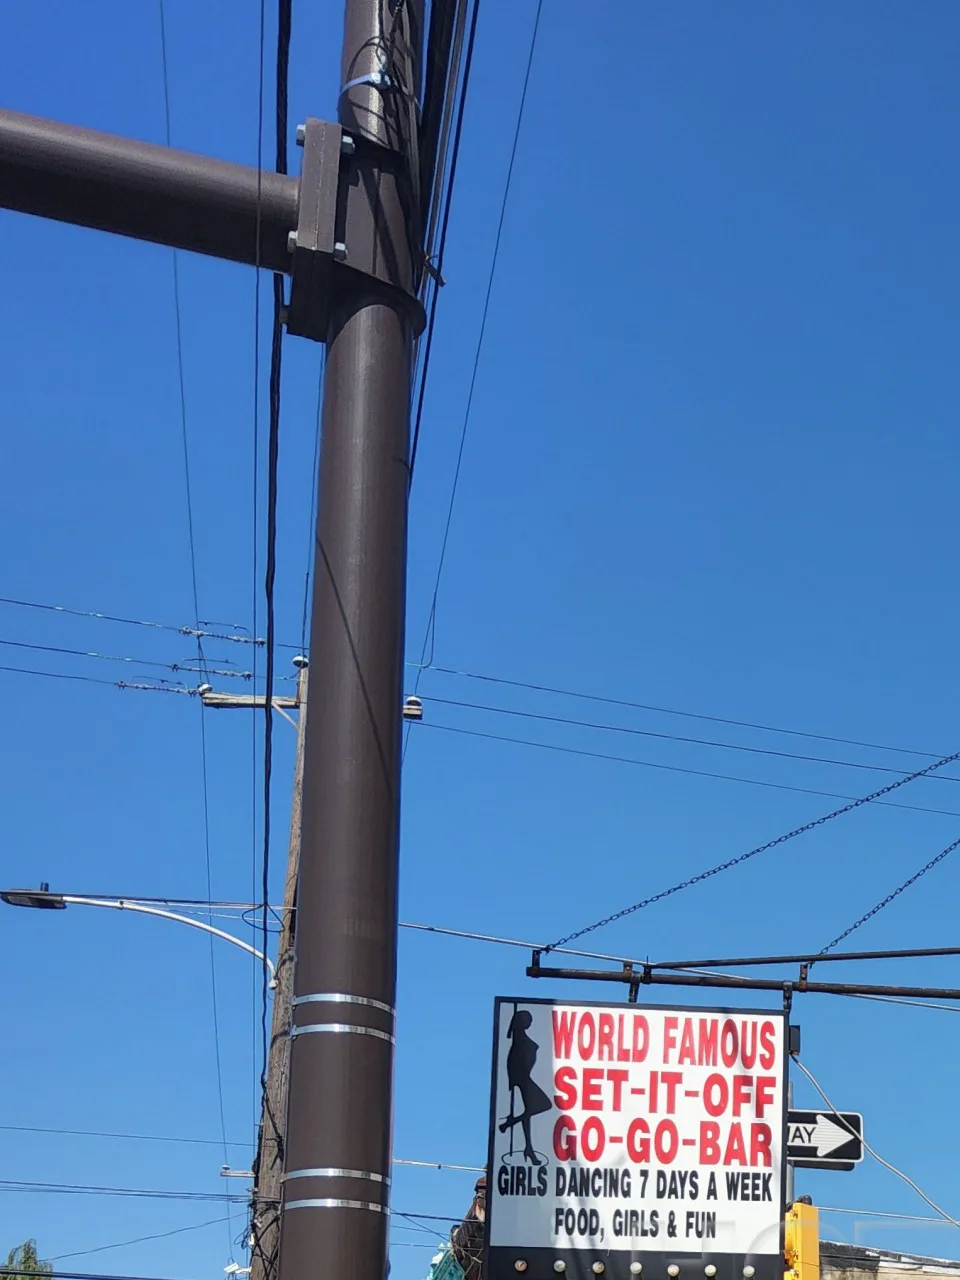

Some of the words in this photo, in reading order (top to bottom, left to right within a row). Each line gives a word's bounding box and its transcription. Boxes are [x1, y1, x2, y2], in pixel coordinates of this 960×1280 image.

[551, 1009, 650, 1063] WORLD
[662, 1015, 776, 1071] FAMOUS
[553, 1065, 777, 1119] SET-IT-OFF
[552, 1114, 773, 1168] GO-GO-BAR
[787, 1125, 817, 1144] AY
[497, 1164, 548, 1197] GIRLS
[555, 1166, 632, 1198] DANCING
[640, 1169, 648, 1198] 7
[656, 1169, 699, 1201] DAYS
[706, 1171, 718, 1201] A
[725, 1171, 773, 1202] WEEK
[554, 1207, 605, 1243] FOOD,
[612, 1209, 659, 1238] GIRLS
[667, 1211, 677, 1238] &
[685, 1211, 716, 1239] FUN
